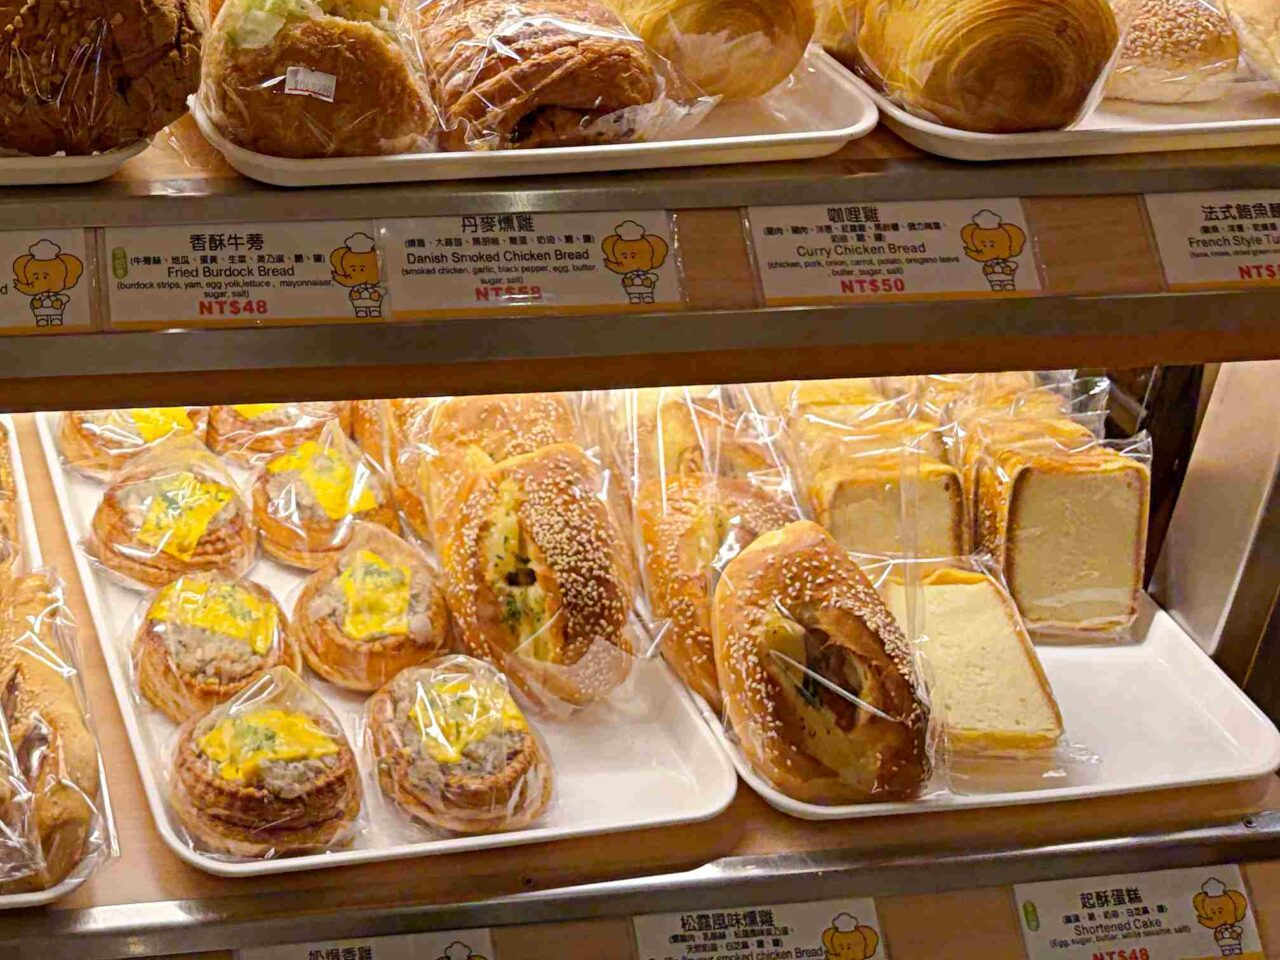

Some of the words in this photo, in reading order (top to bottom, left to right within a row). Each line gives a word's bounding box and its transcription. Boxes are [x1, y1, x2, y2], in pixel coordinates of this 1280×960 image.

[462, 216, 535, 233] 丹麥燻雞
[190, 233, 265, 251] 香酥牛蒡
[1188, 237, 1230, 248] French
[1233, 235, 1262, 248] Style
[407, 252, 448, 264] Danish
[452, 251, 500, 263] Smoked
[503, 250, 550, 261] Chicken
[555, 249, 589, 260] Bread
[797, 245, 831, 258] Curry
[835, 245, 884, 256] Chicken
[888, 243, 926, 254] Bread
[168, 267, 198, 278] Fried
[203, 267, 254, 277] Burdock
[258, 265, 295, 276] Bread
[498, 265, 519, 273] black
[1238, 264, 1280, 279] NT$
[206, 281, 222, 290] egg
[840, 278, 905, 293] NT$50
[199, 300, 268, 316] NT$48
[1080, 887, 1143, 910] 起酥蛋糕
[1074, 921, 1132, 936] Shortened
[1134, 919, 1162, 930] Cake
[795, 947, 822, 959] Bread
